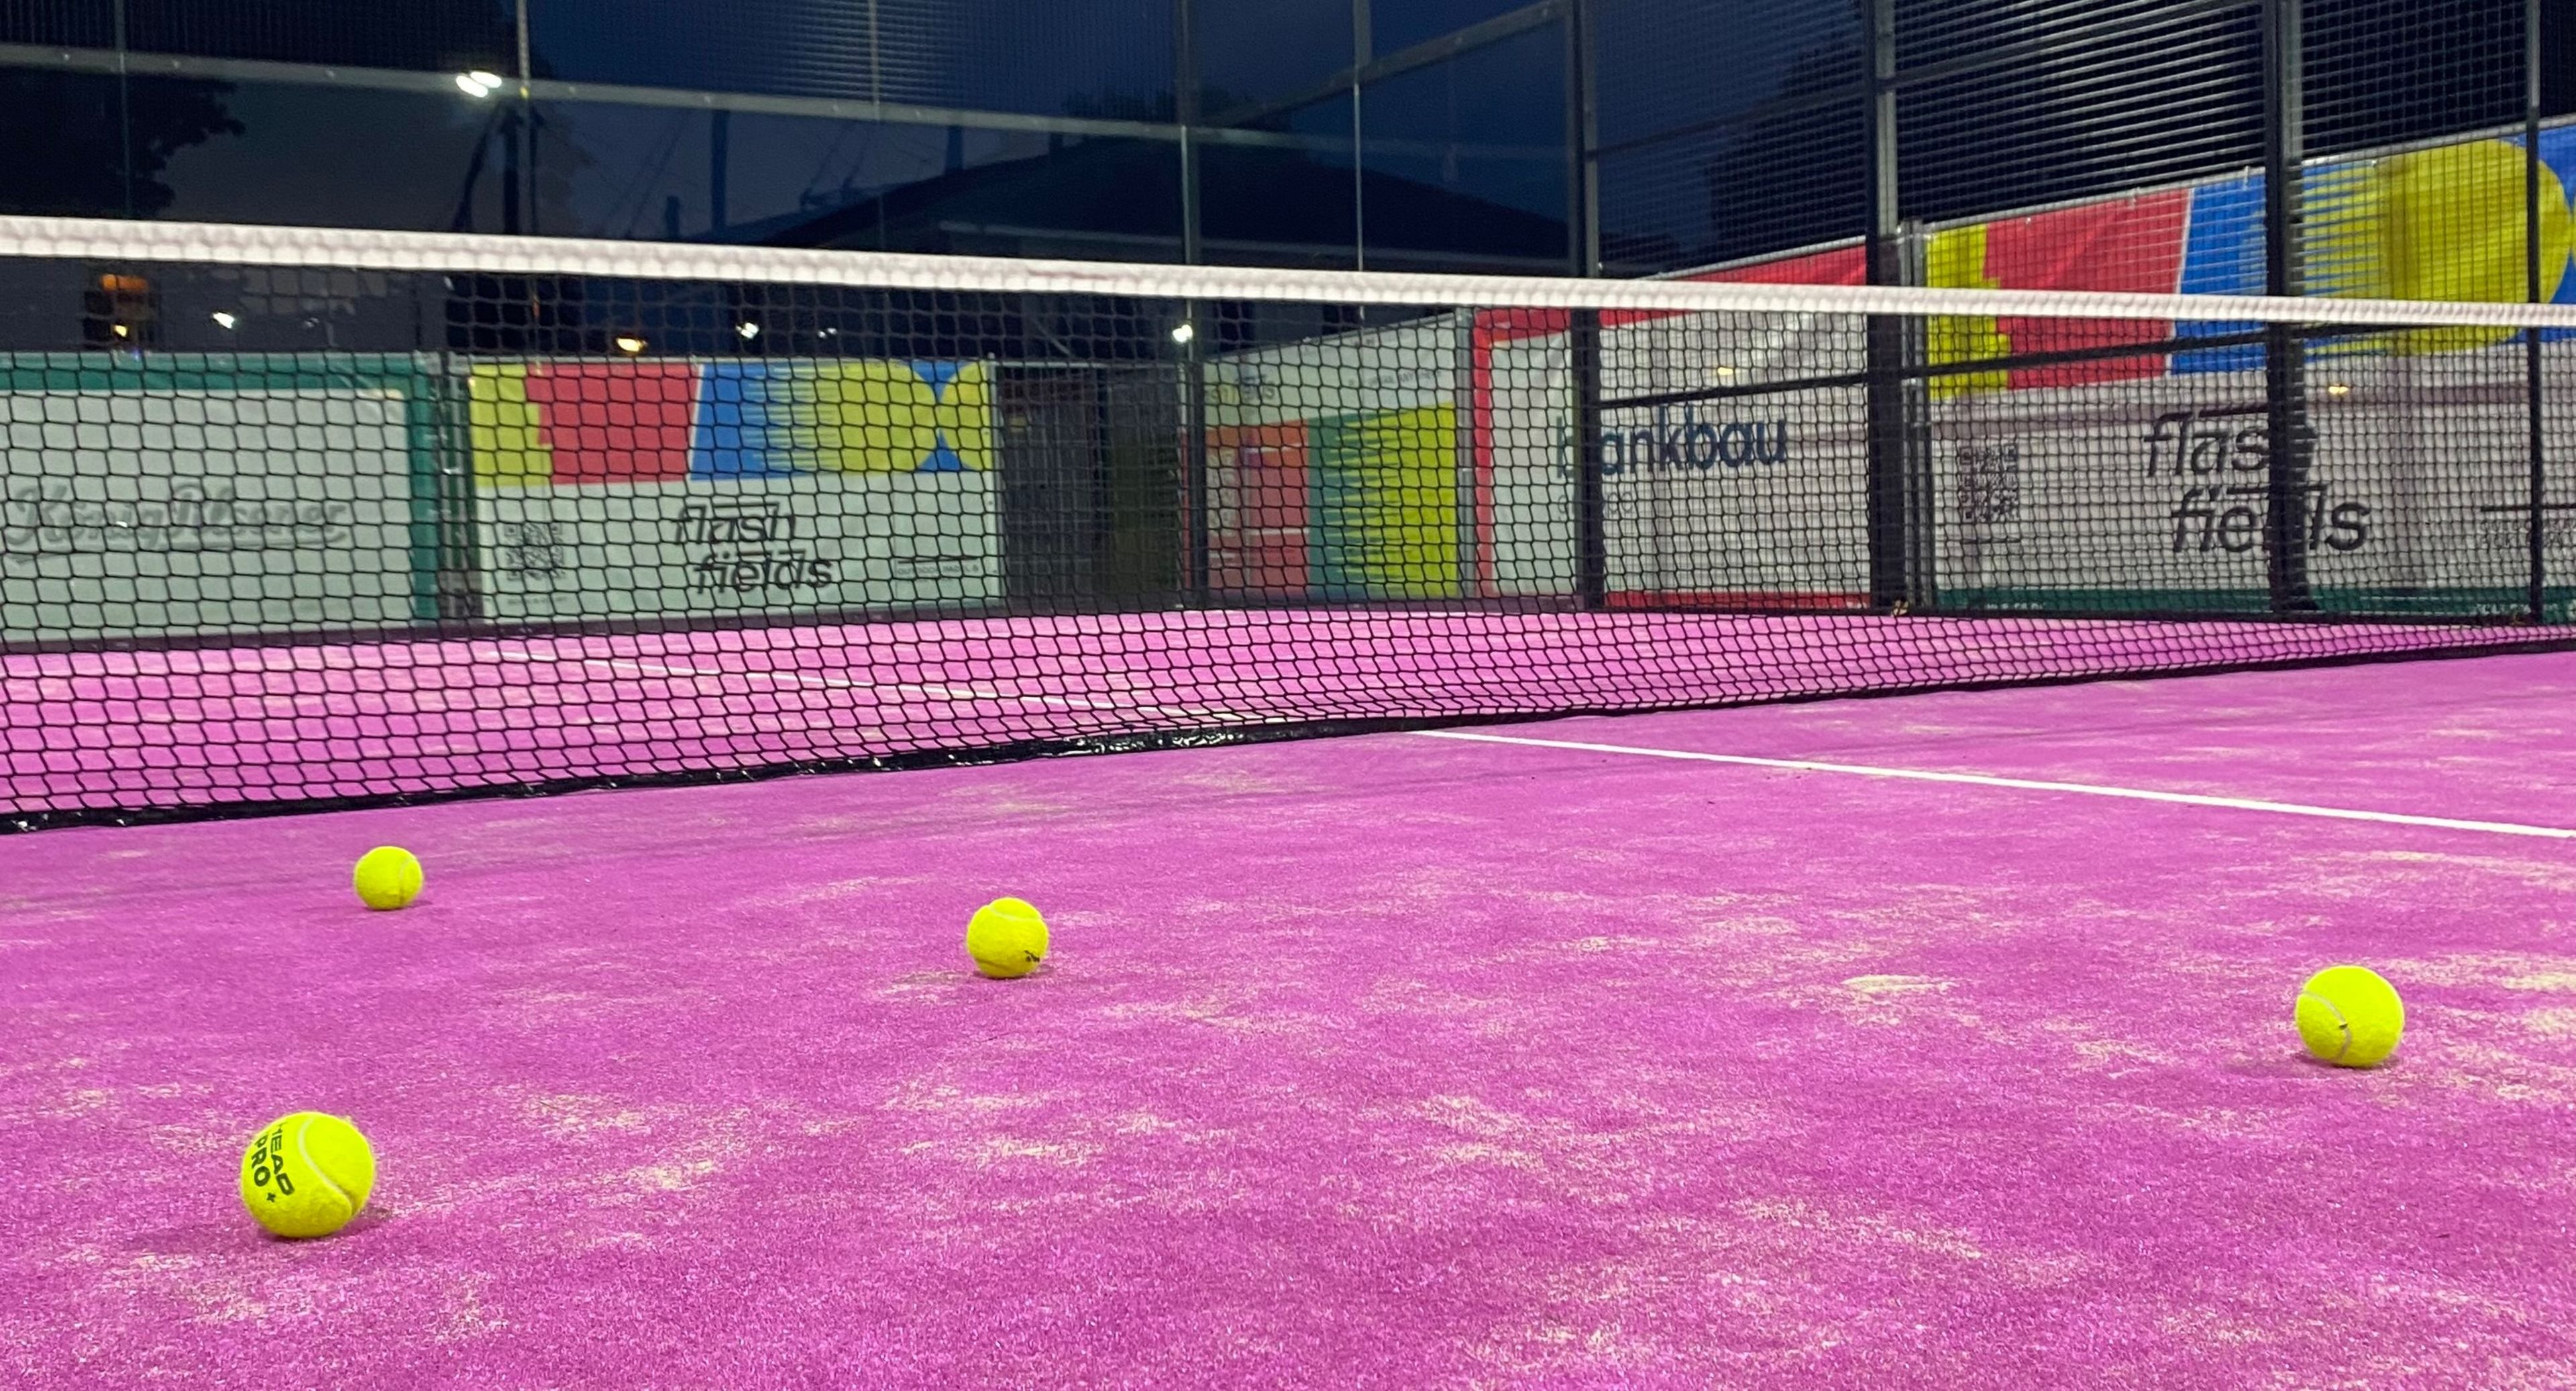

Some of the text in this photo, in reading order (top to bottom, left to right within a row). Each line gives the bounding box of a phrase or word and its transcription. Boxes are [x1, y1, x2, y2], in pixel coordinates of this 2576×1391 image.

[2144, 404, 2318, 478] flas
[671, 502, 796, 545] flash
[2171, 483, 2371, 553] fies
[694, 548, 833, 594] fields
[270, 1121, 295, 1197] HEAD
